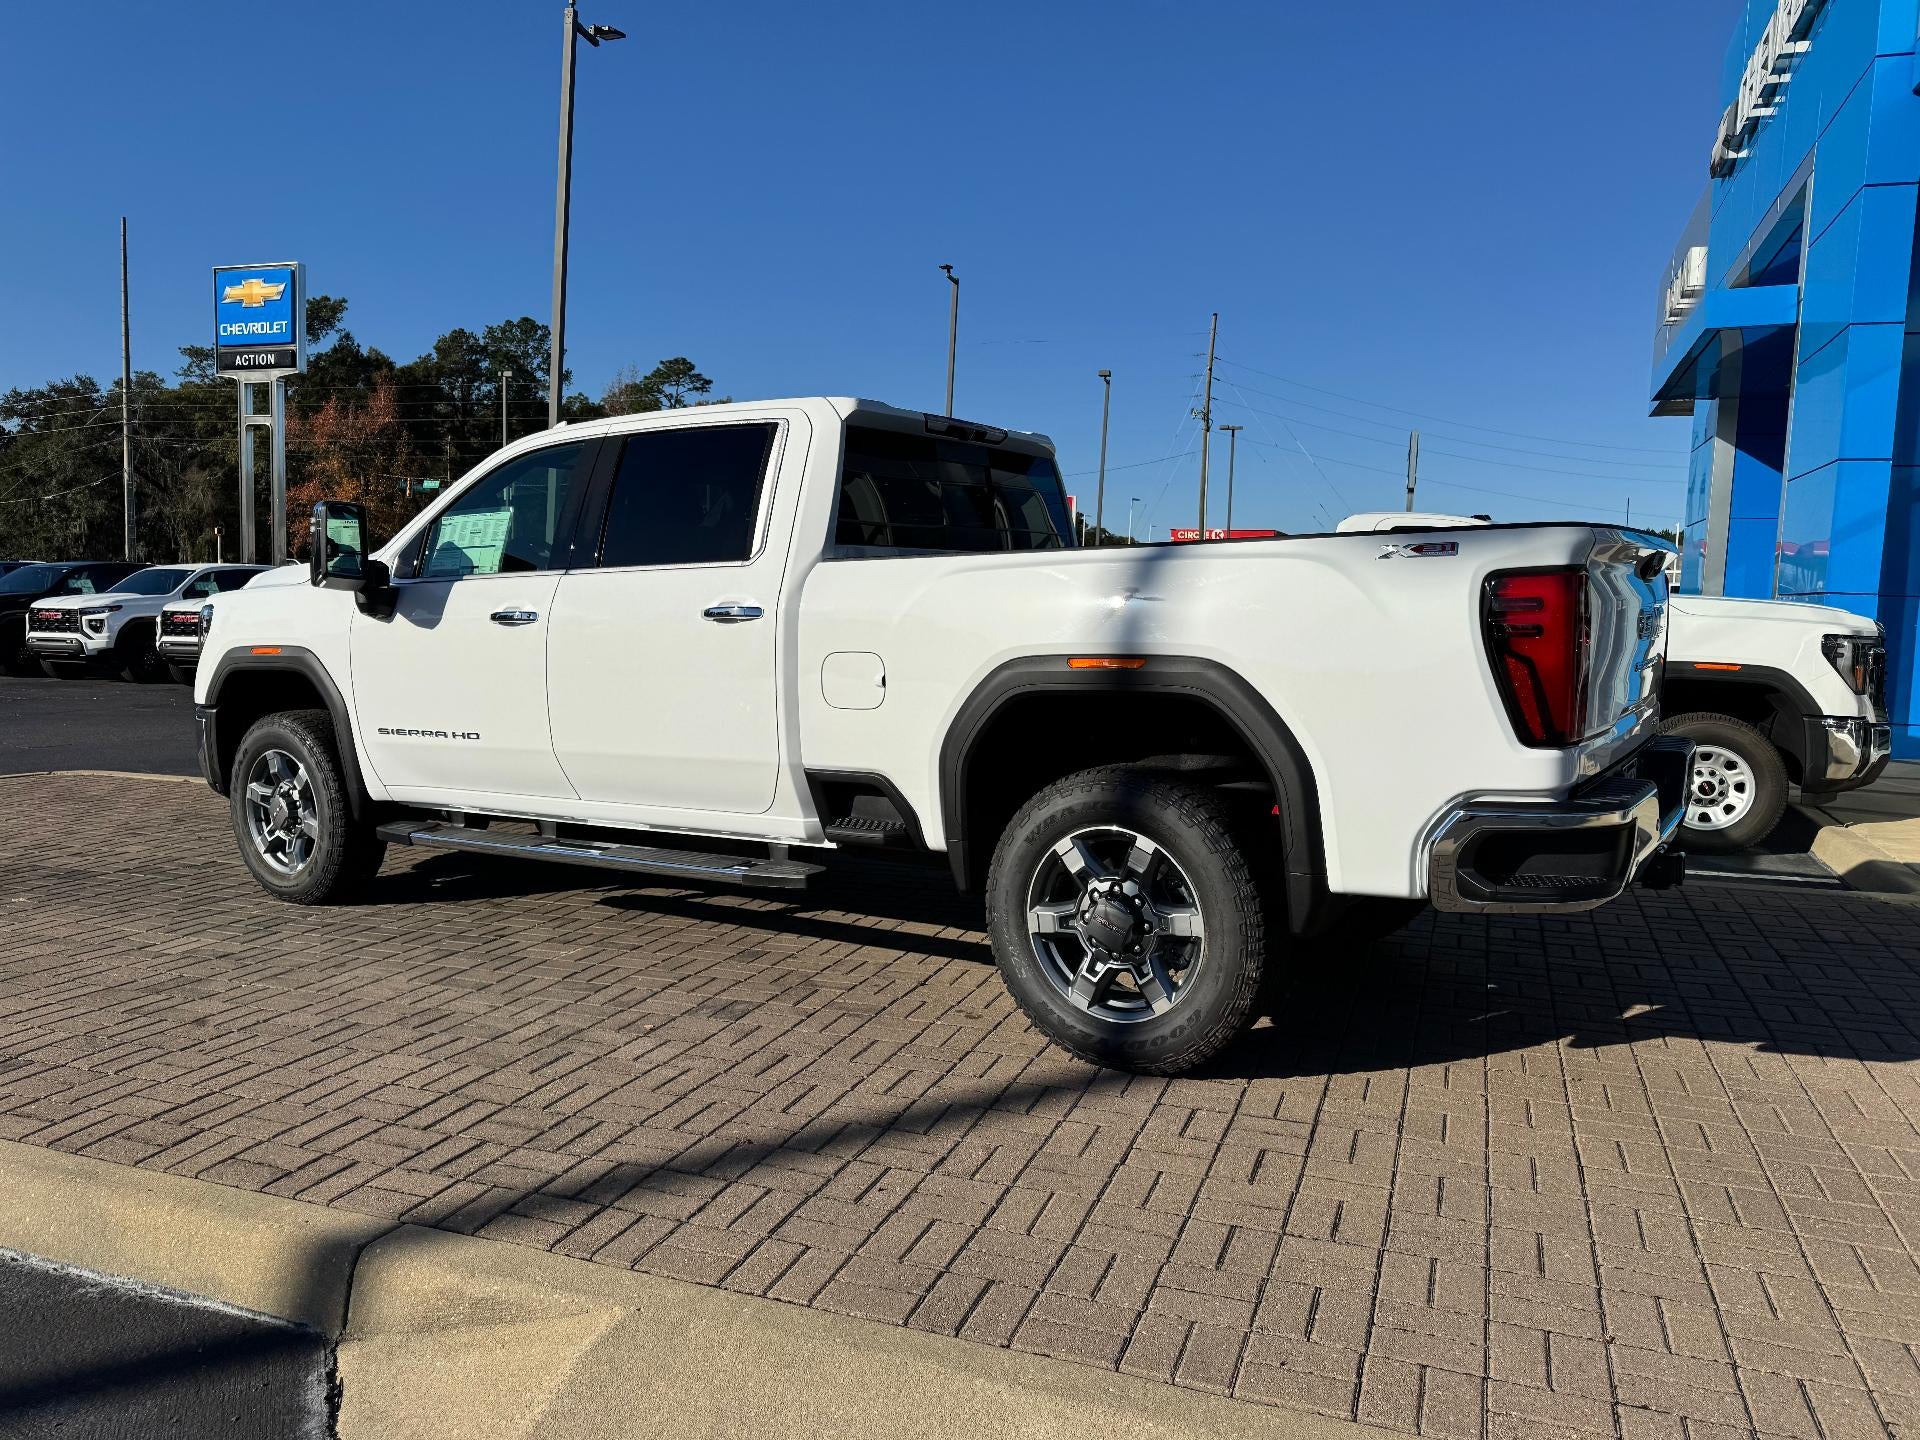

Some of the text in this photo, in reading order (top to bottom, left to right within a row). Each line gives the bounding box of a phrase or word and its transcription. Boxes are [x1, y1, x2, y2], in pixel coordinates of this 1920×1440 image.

[220, 321, 288, 336] CHEVROLET
[235, 353, 275, 366] ACTION
[1177, 530, 1224, 539] CIRCE K
[377, 727, 480, 740] SIERRA HD
